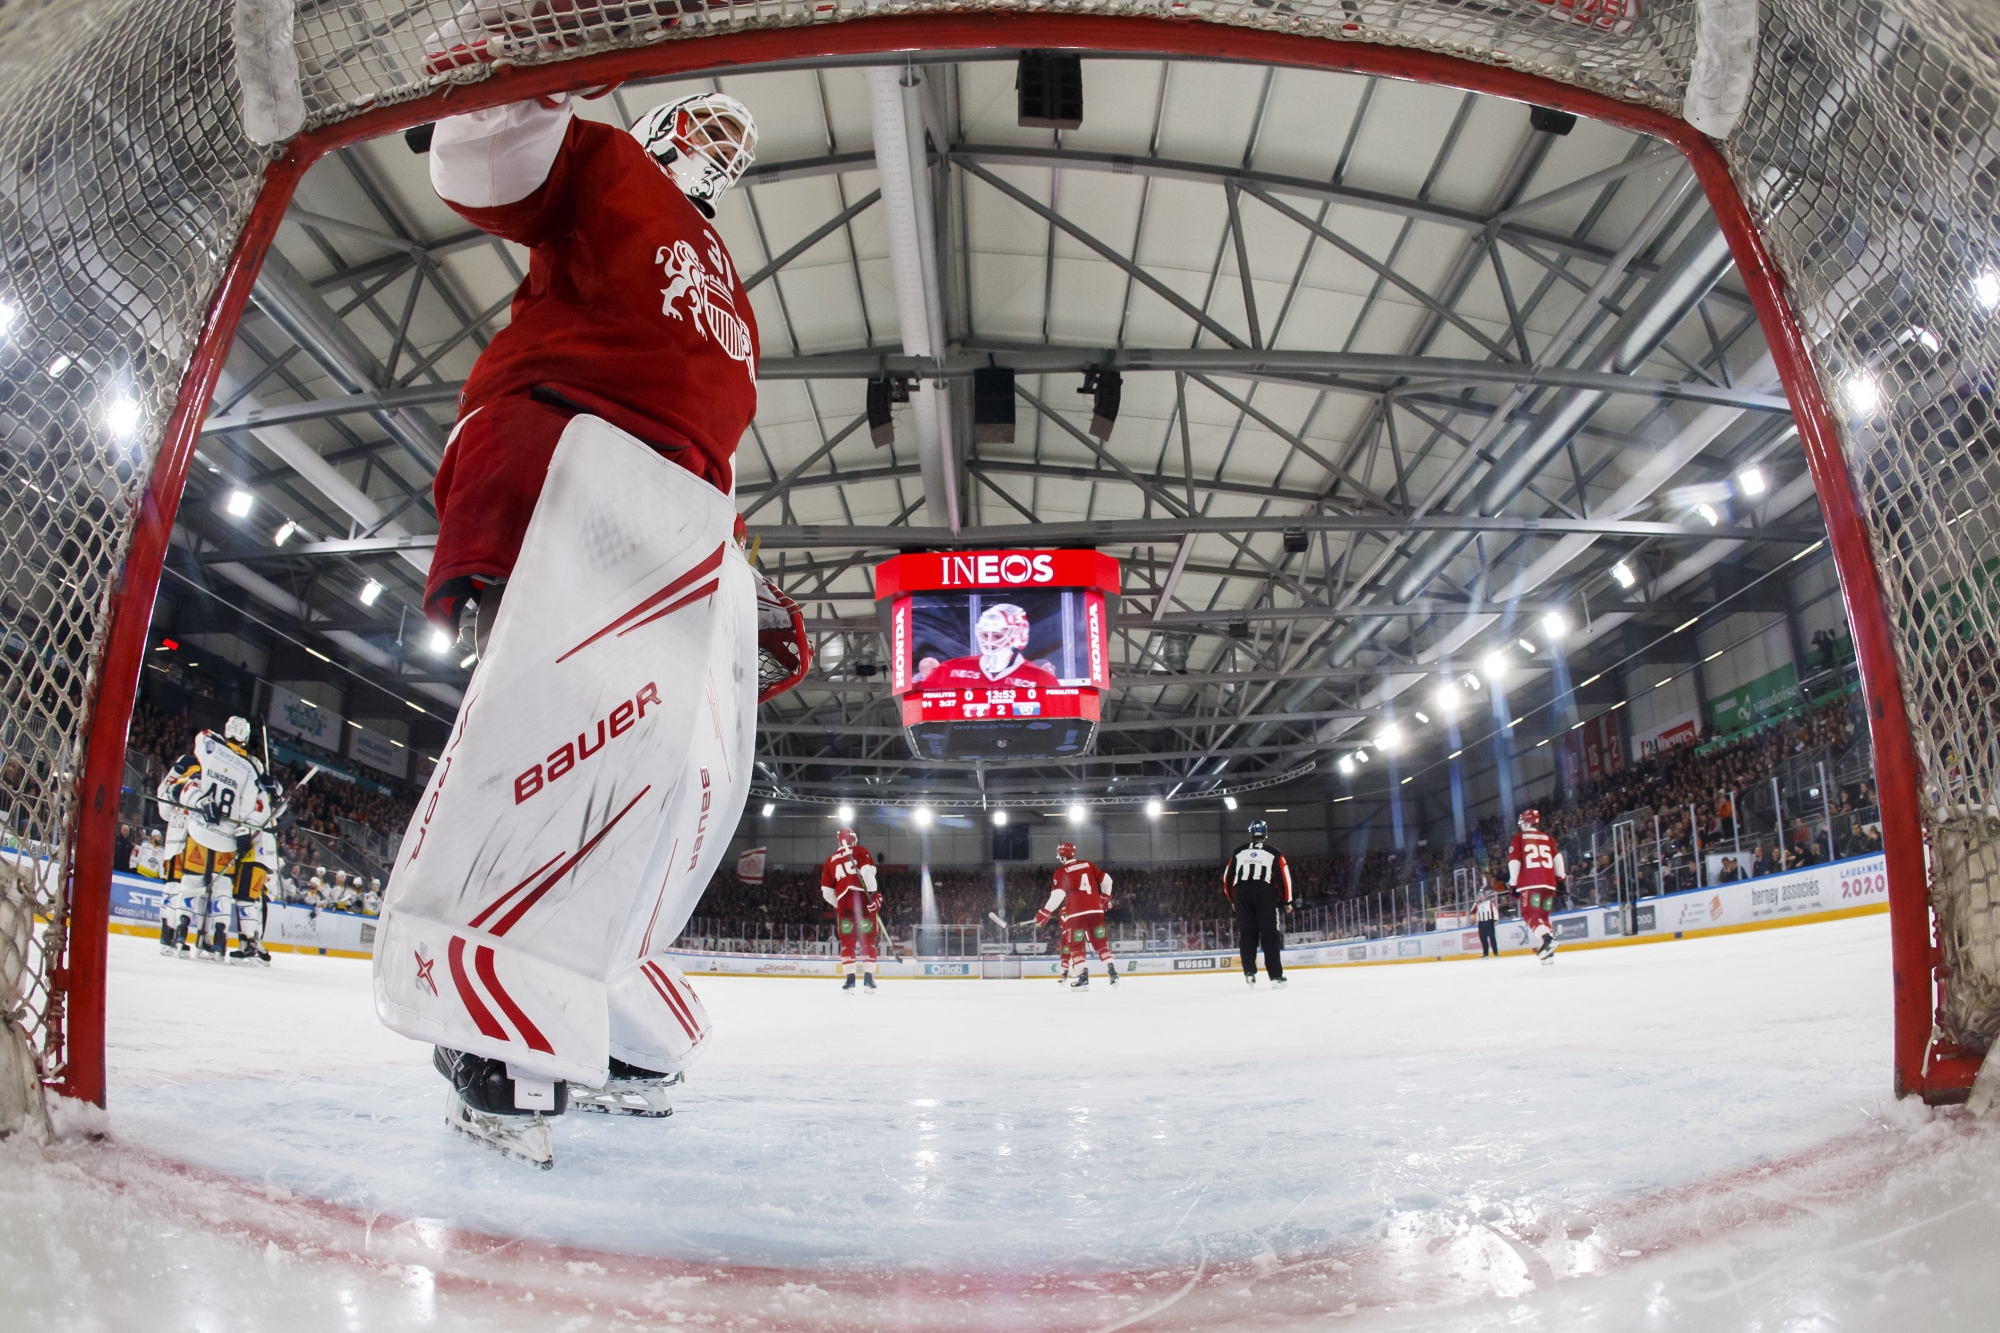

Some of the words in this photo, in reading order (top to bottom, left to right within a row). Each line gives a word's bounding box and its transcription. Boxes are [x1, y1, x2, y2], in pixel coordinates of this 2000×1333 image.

[941, 554, 1054, 585] INEOS
[895, 607, 905, 689] HONDA
[1089, 602, 1102, 683] HONDA
[964, 690, 974, 702] 0
[985, 689, 1017, 700] 13:53
[1027, 689, 1037, 700] 0
[1753, 685, 1797, 712] vaudoise
[996, 704, 1006, 716] 2
[1523, 843, 1554, 869] 25
[1840, 861, 1884, 879] LAUSANNE
[1079, 873, 1092, 895] 4
[1781, 876, 1820, 901] associés
